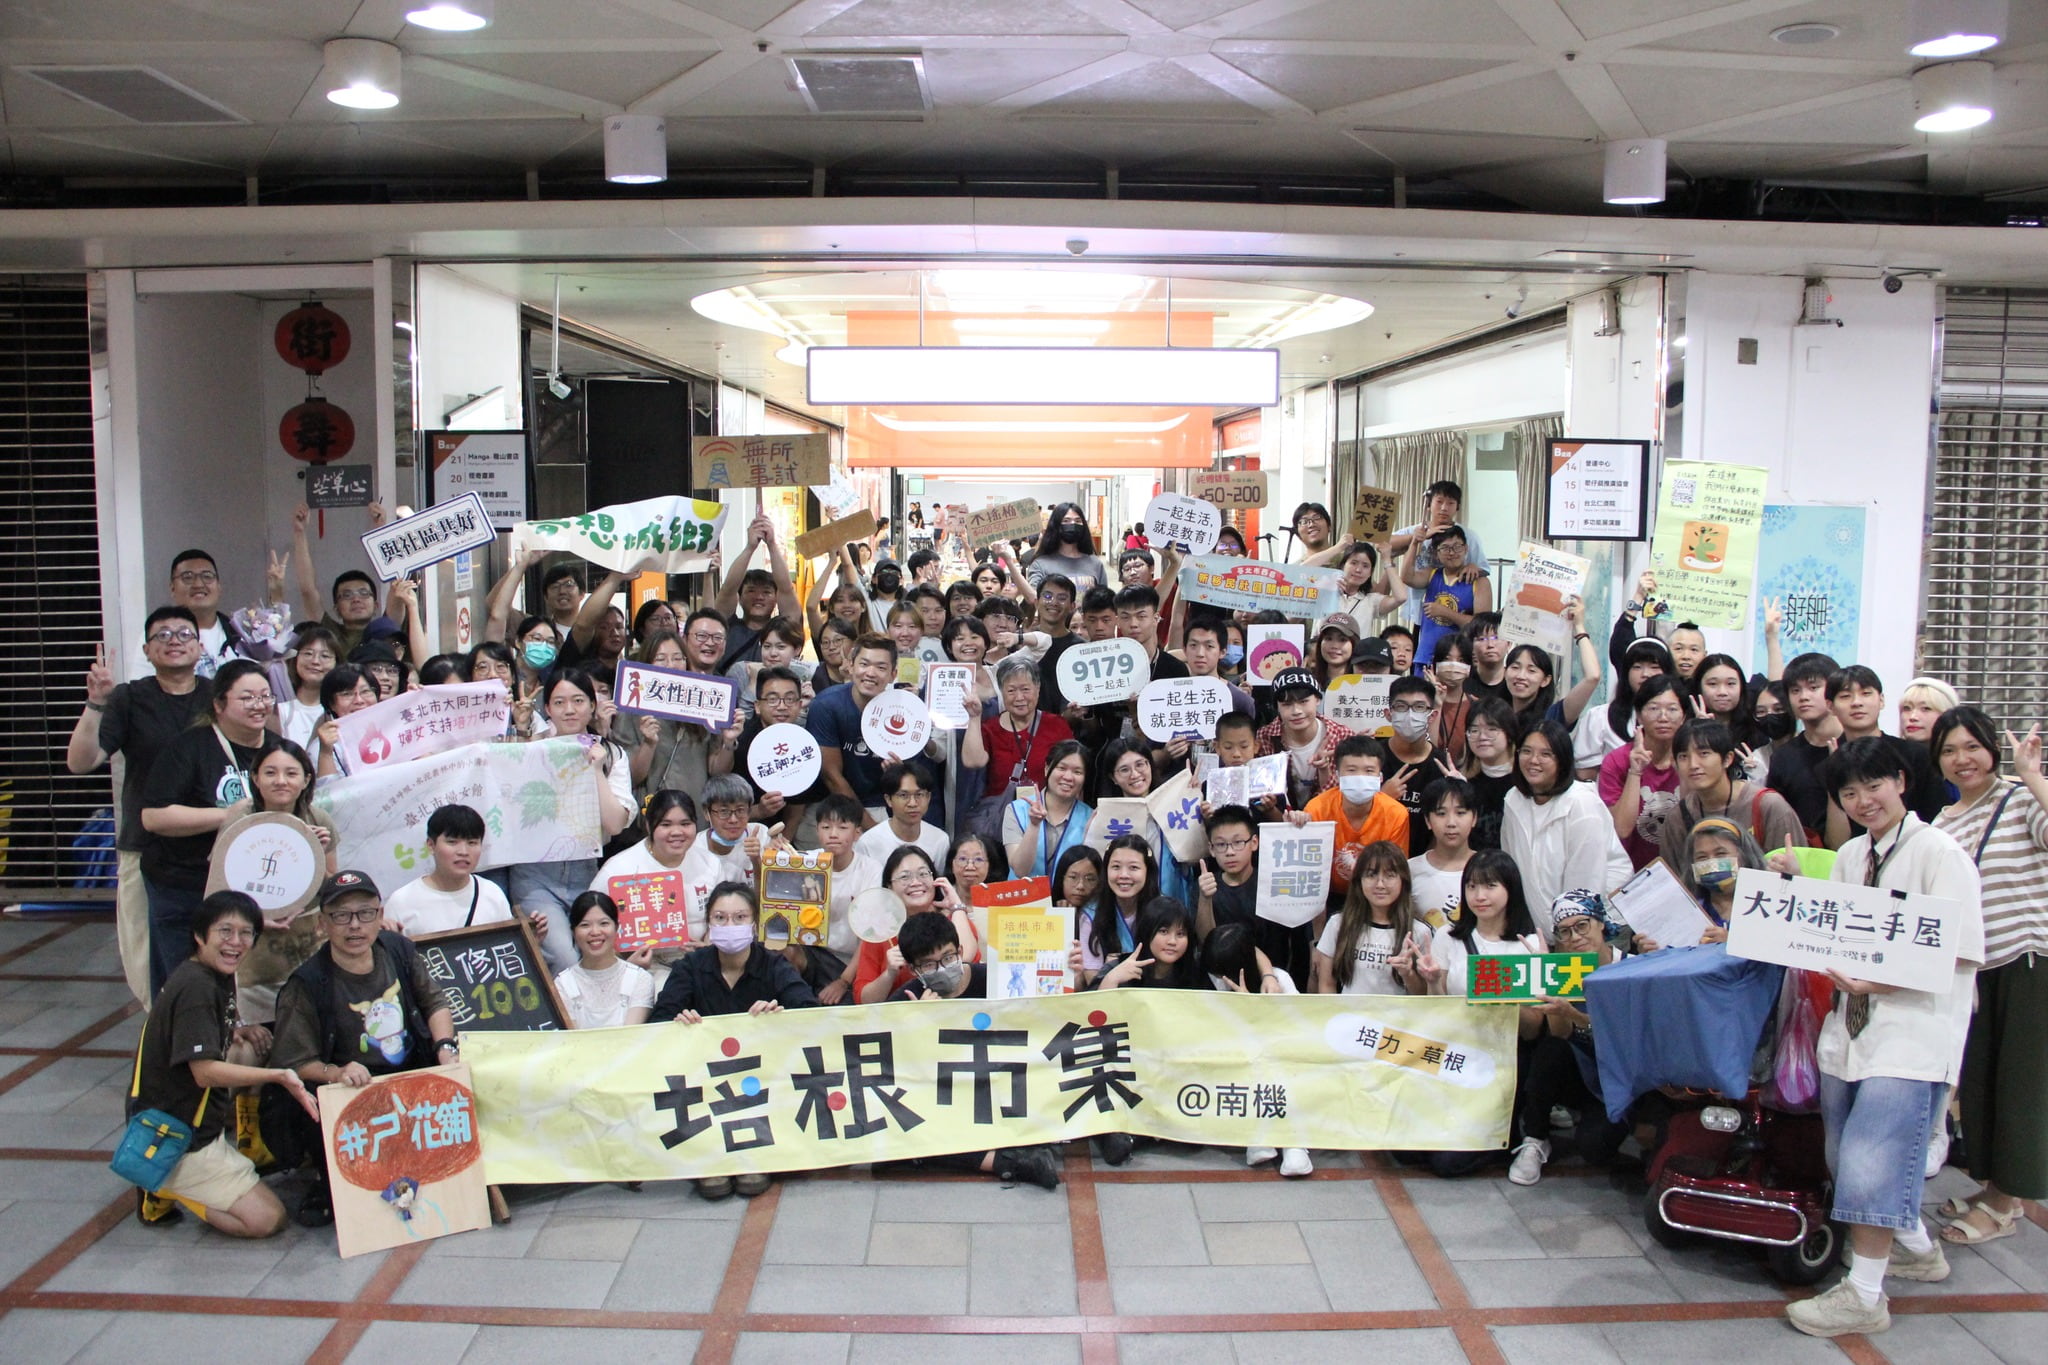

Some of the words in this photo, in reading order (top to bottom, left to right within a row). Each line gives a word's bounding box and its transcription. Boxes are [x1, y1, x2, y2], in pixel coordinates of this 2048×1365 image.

[450, 456, 462, 464] 21
[742, 440, 794, 464] 無所
[450, 475, 462, 484] 20
[1566, 463, 1576, 471] 14
[1565, 481, 1576, 490] 15
[1361, 493, 1395, 513] 好坐
[1564, 501, 1576, 510] 16
[380, 509, 477, 566] 與社區共好
[1564, 520, 1576, 528] 17
[1197, 572, 1319, 600] 新移民社區關懷據點
[938, 670, 967, 680] 古著屋
[1072, 654, 1134, 682] 9179
[645, 678, 726, 711] 女性自立
[1083, 677, 1132, 694] 走一起走！
[400, 692, 498, 724] 臺北市大同士林
[398, 709, 505, 748] 婦女支持培力中心
[1271, 838, 1324, 868] 社區
[1270, 870, 1322, 898] 實踐
[626, 884, 665, 913] 萬華
[618, 912, 686, 940] 社區小學
[1004, 920, 1056, 935] 培根市集
[1742, 890, 1942, 948] 大水溝二手屋
[455, 942, 528, 984] 修眉
[471, 976, 540, 1020] 100
[653, 1011, 1143, 1152] 培根市集
[1176, 1082, 1288, 1120] @南機
